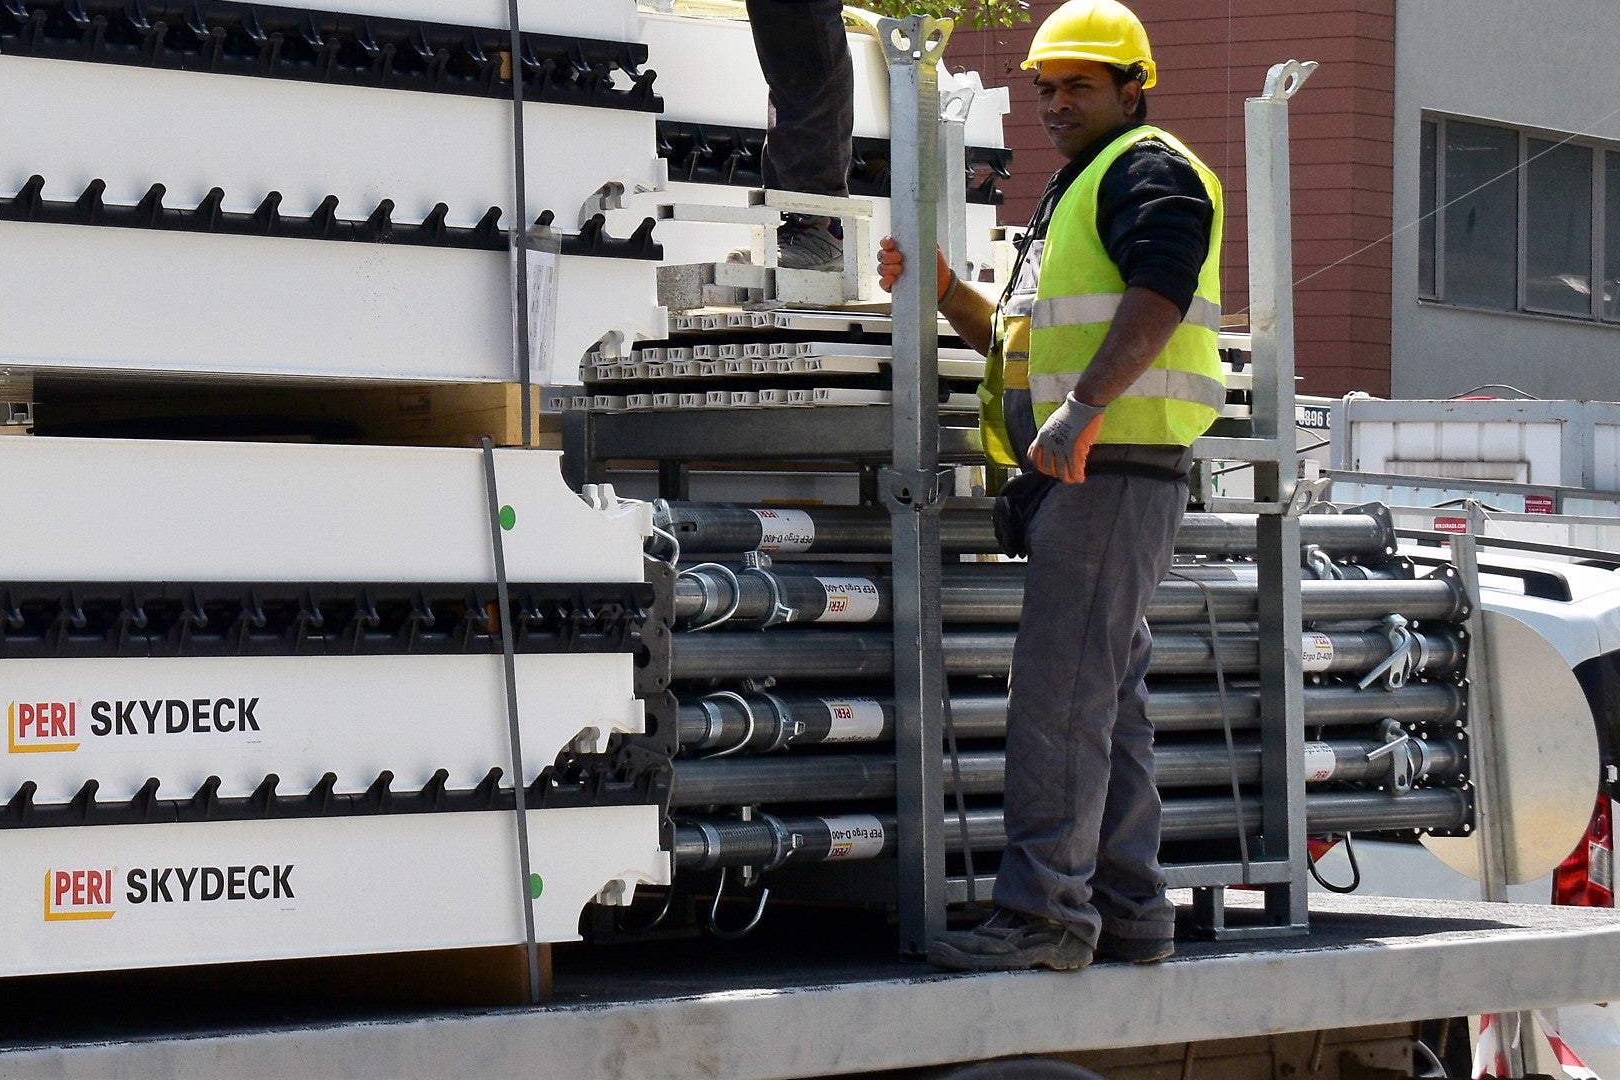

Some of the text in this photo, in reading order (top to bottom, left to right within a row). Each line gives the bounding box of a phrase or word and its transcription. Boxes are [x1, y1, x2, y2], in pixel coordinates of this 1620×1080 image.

[1298, 410, 1324, 427] 896
[784, 533, 799, 544] Ergo
[828, 601, 845, 611] PERI
[18, 697, 261, 738] PERI SKYDECK
[833, 708, 851, 719] PERI
[831, 827, 882, 840] PEP Ergo D-400
[55, 864, 296, 906] PERI SKYDECK
